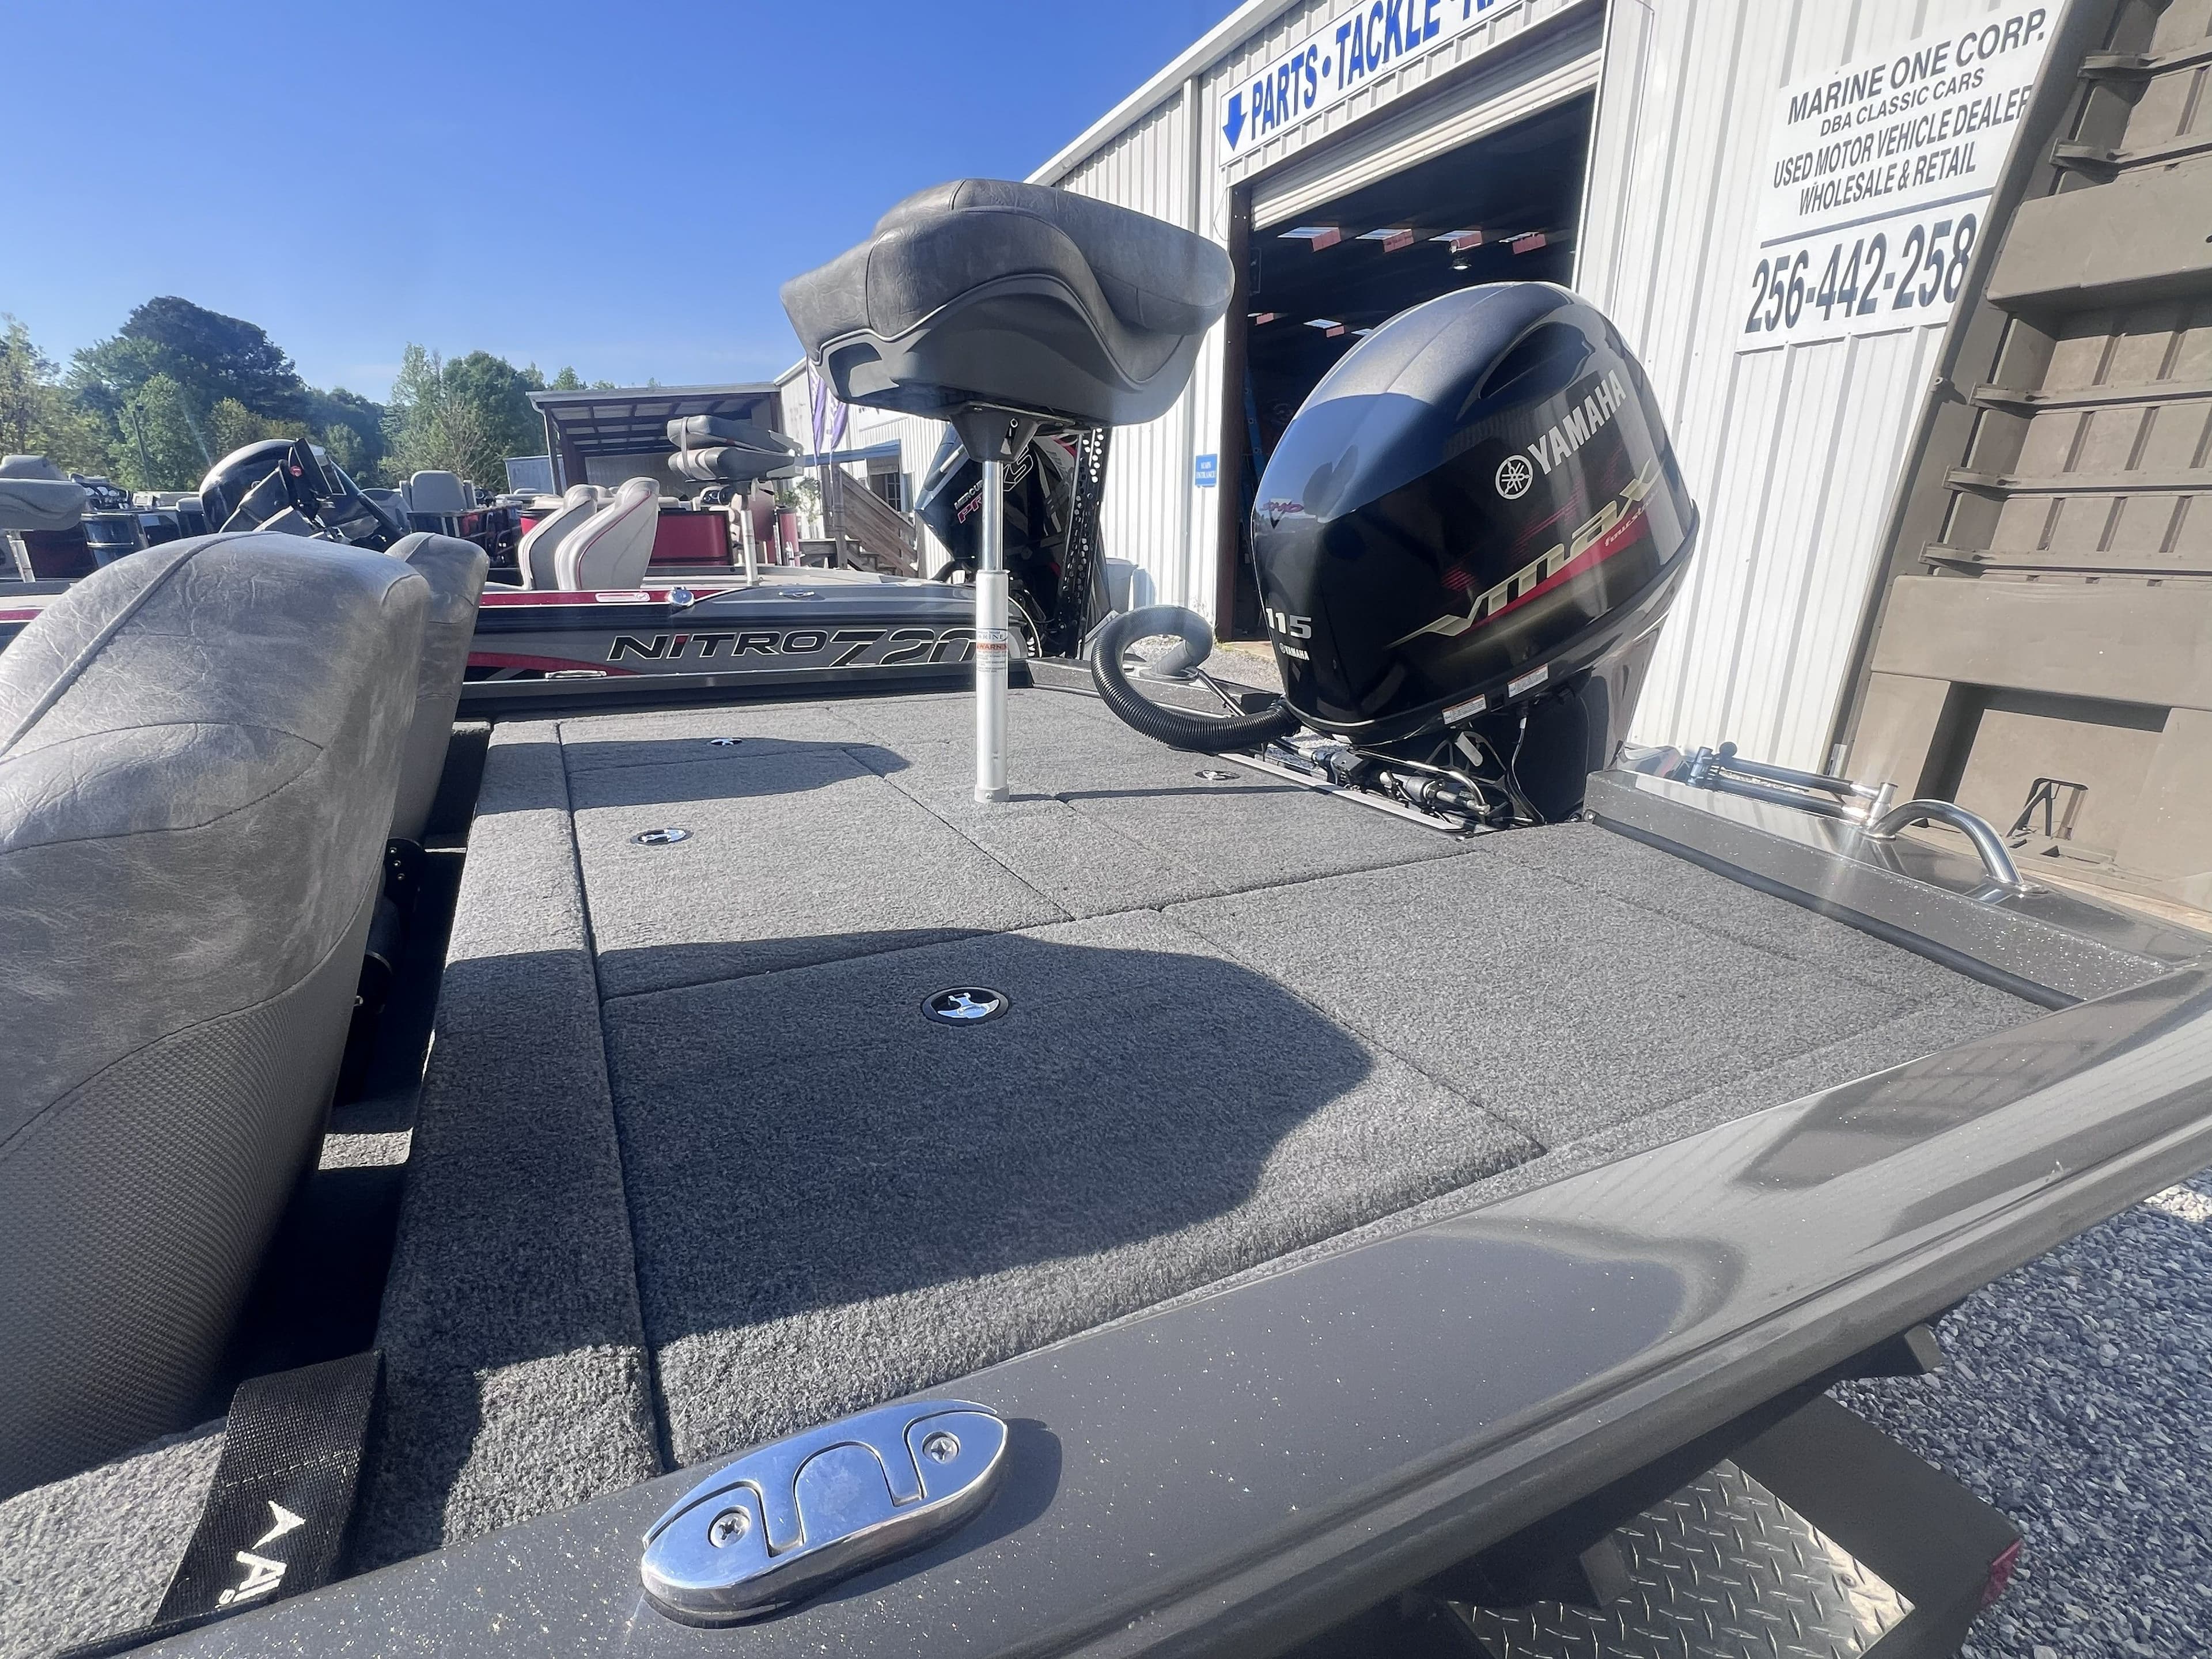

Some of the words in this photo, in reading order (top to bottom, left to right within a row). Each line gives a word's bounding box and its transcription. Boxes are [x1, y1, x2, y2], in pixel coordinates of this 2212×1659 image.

[1251, 44, 1317, 142] PARTS
[1336, 0, 1440, 90] TACKLE
[1787, 63, 1887, 125] MARINE
[1890, 40, 1952, 89] ONE
[1955, 8, 2046, 67] CORP.
[1820, 115, 1851, 137] DBA
[1856, 86, 1930, 126] CLASSIC
[1933, 67, 1984, 100] CARS
[1774, 151, 1813, 188] USED
[1813, 133, 1874, 177] MOTOR
[1877, 108, 1953, 159] VEHICLE
[1799, 163, 1897, 216] WHOLESALE
[1897, 160, 1910, 191] &
[1912, 141, 1976, 185] RETAIL
[1744, 213, 1977, 334] 256-442-258
[1528, 370, 1626, 475] YAMAHA
[954, 479, 983, 510] MERCU
[958, 492, 983, 524] PR
[606, 629, 829, 662] NITRO
[1266, 608, 1311, 639] 115
[1285, 645, 1309, 661] YAMAHA
